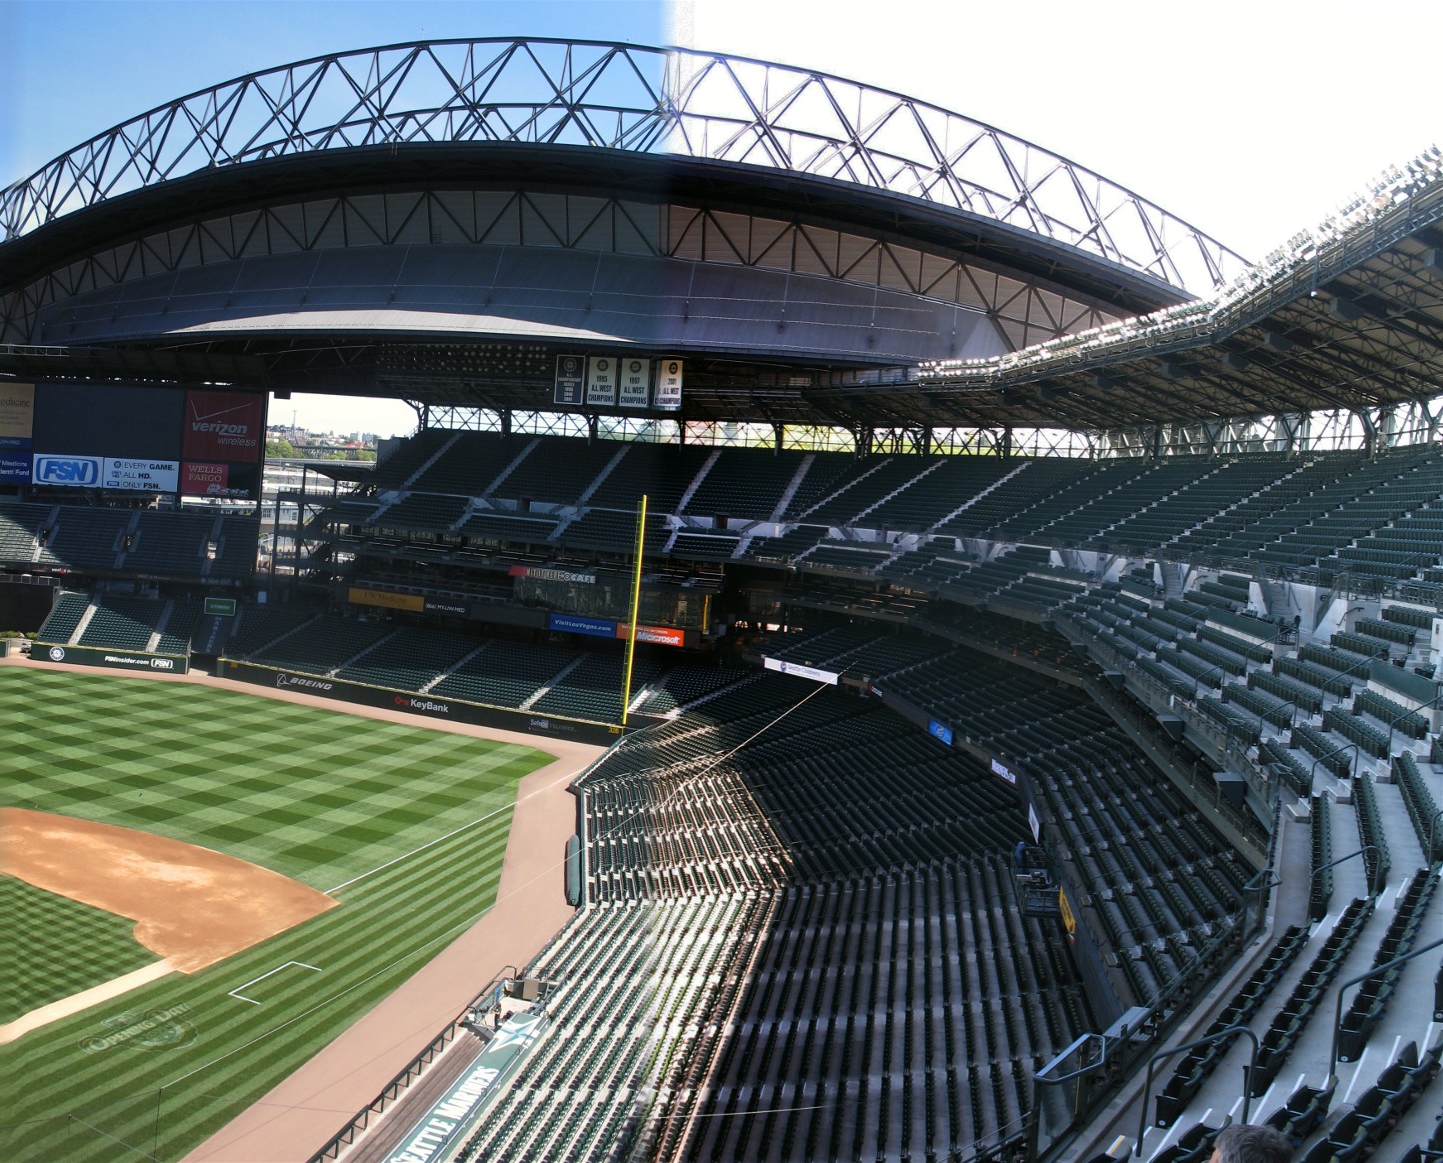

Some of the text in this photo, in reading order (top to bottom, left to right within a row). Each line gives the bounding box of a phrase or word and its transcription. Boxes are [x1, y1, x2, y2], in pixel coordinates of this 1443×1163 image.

[596, 375, 607, 383] 1995
[632, 386, 644, 394] WEST
[588, 394, 614, 402] CHAMPIONS
[620, 396, 647, 404] CHAMPIONS
[192, 420, 248, 436] verizon
[218, 435, 256, 447] wireless
[124, 462, 175, 471] EVERY GAME.
[188, 465, 223, 474] WELLS
[44, 461, 89, 482] FSN
[188, 473, 222, 482] FARGO
[143, 482, 161, 490] FSN.
[570, 573, 596, 583] CAFE
[104, 655, 171, 668] FSNinsider.com FSN
[289, 677, 333, 691] BOEING
[410, 698, 449, 713] KeyBank
[433, 1065, 500, 1121] MARINERS
